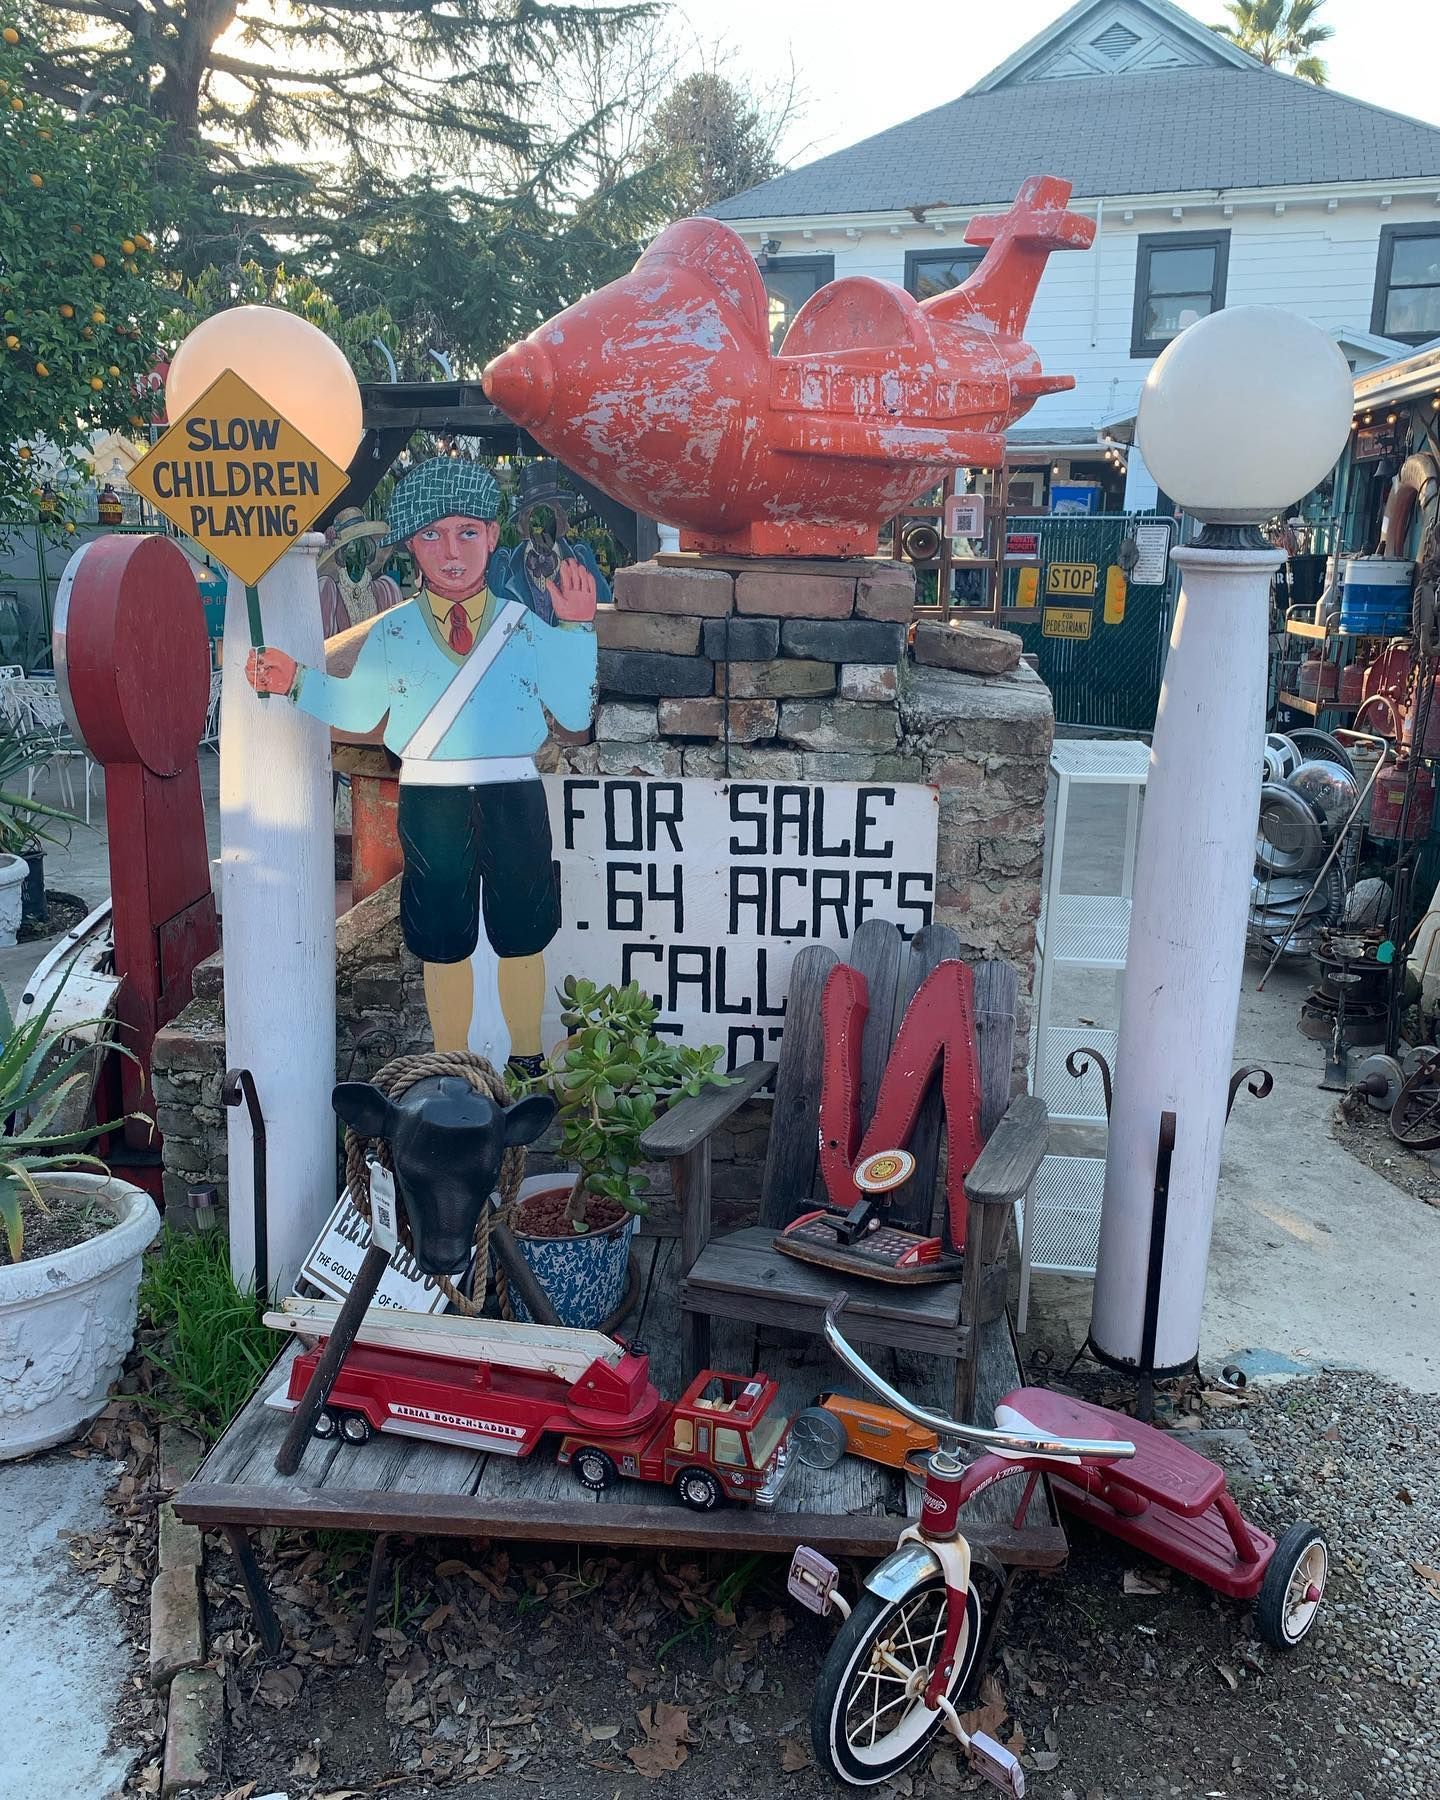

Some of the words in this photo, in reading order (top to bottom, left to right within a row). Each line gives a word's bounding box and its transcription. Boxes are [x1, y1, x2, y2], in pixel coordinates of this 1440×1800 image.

[185, 417, 281, 452] SLOW
[153, 461, 320, 499] CHILDREN
[190, 504, 298, 537] PLAYING
[1009, 535, 1035, 543] PRIVATE
[1051, 568, 1092, 589] STOP
[1046, 619, 1087, 634] PEDESTRIANS
[564, 779, 683, 852] FOR
[729, 784, 896, 858] SALE
[729, 866, 933, 942] ACRES
[622, 943, 788, 1017] CALL
[315, 1251, 332, 1267] THE
[331, 1261, 357, 1284] GOLDE
[378, 1294, 392, 1307] OF
[397, 1406, 431, 1419] AERIAL
